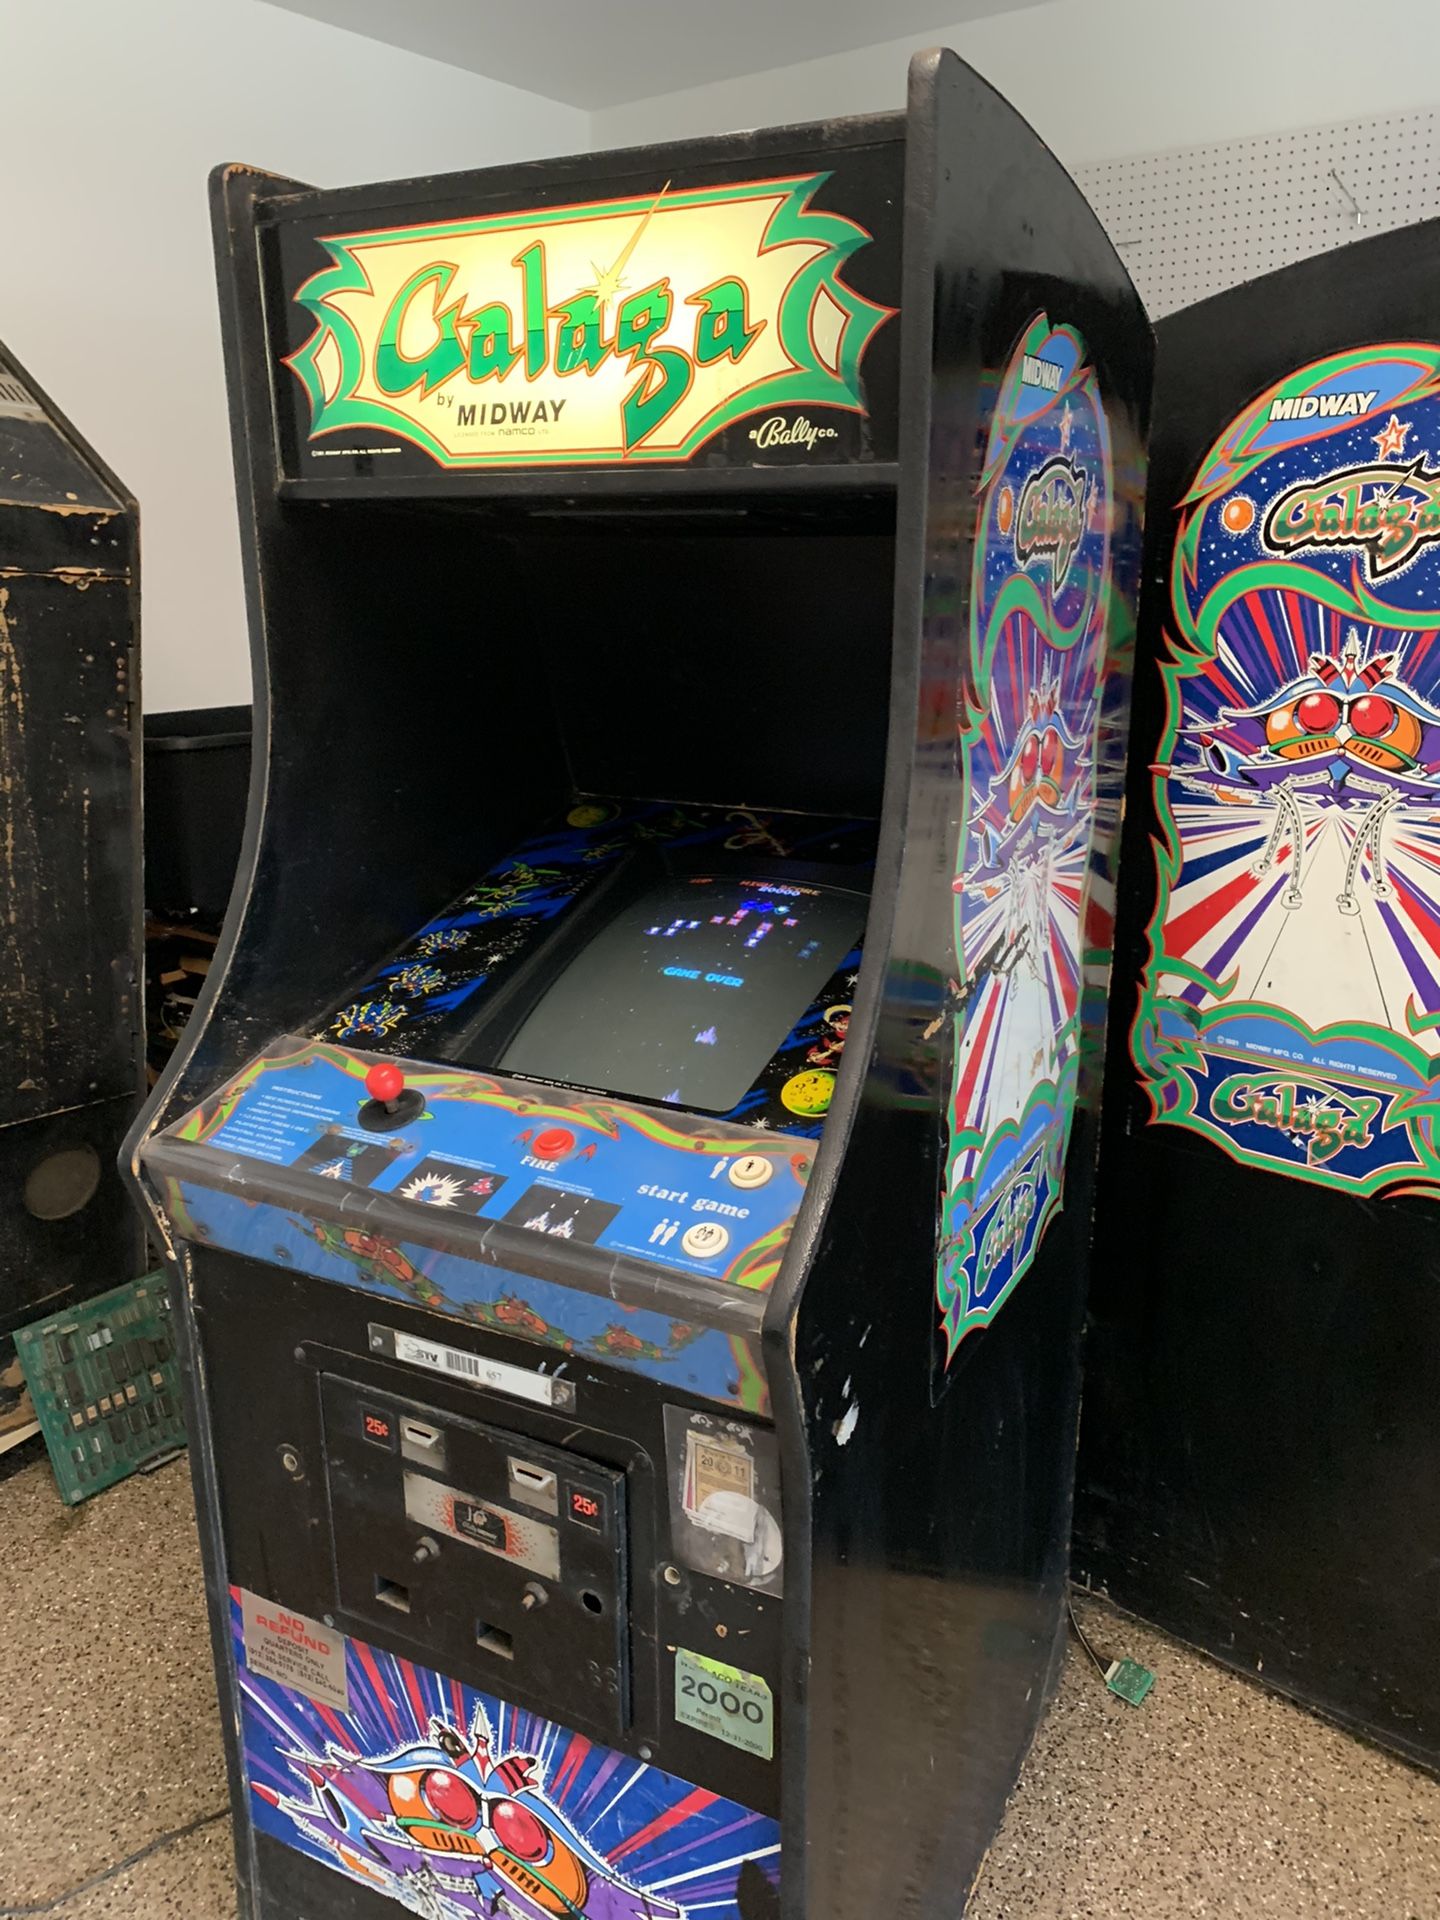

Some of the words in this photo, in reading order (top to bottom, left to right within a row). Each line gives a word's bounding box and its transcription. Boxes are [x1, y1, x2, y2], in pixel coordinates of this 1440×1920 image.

[374, 239, 768, 458] Galaga
[1021, 354, 1064, 393] MIDWAY
[437, 391, 454, 408] by
[457, 399, 567, 426] MIDWAY
[1269, 390, 1378, 421] MIDWAY
[498, 426, 536, 437] namco
[748, 429, 758, 440] a
[757, 415, 819, 451] Bally
[663, 966, 702, 980] GAME
[704, 972, 745, 988] OVER
[1245, 1042, 1272, 1054] MIDWAY
[1311, 1056, 1327, 1066] ALL
[1328, 1059, 1356, 1072] RIGHTS
[1358, 1066, 1398, 1081] RESERVED
[1210, 1073, 1383, 1167] Galaga
[519, 1155, 559, 1172] FIRE
[636, 1183, 689, 1204] start
[690, 1197, 751, 1220] game
[366, 1416, 389, 1437] 25¢
[701, 1454, 714, 1468] 20
[255, 1614, 331, 1656] REFUND
[277, 1612, 305, 1633] NO
[263, 1637, 304, 1661] QUARTERS
[304, 1655, 325, 1670] ONLY
[277, 1635, 309, 1655] DEPOSIT
[260, 1644, 277, 1656] FOR
[277, 1652, 308, 1670] SERVICE
[310, 1667, 329, 1682] CALL
[681, 1674, 764, 1725] 2000
[696, 1707, 722, 1722] Permit
